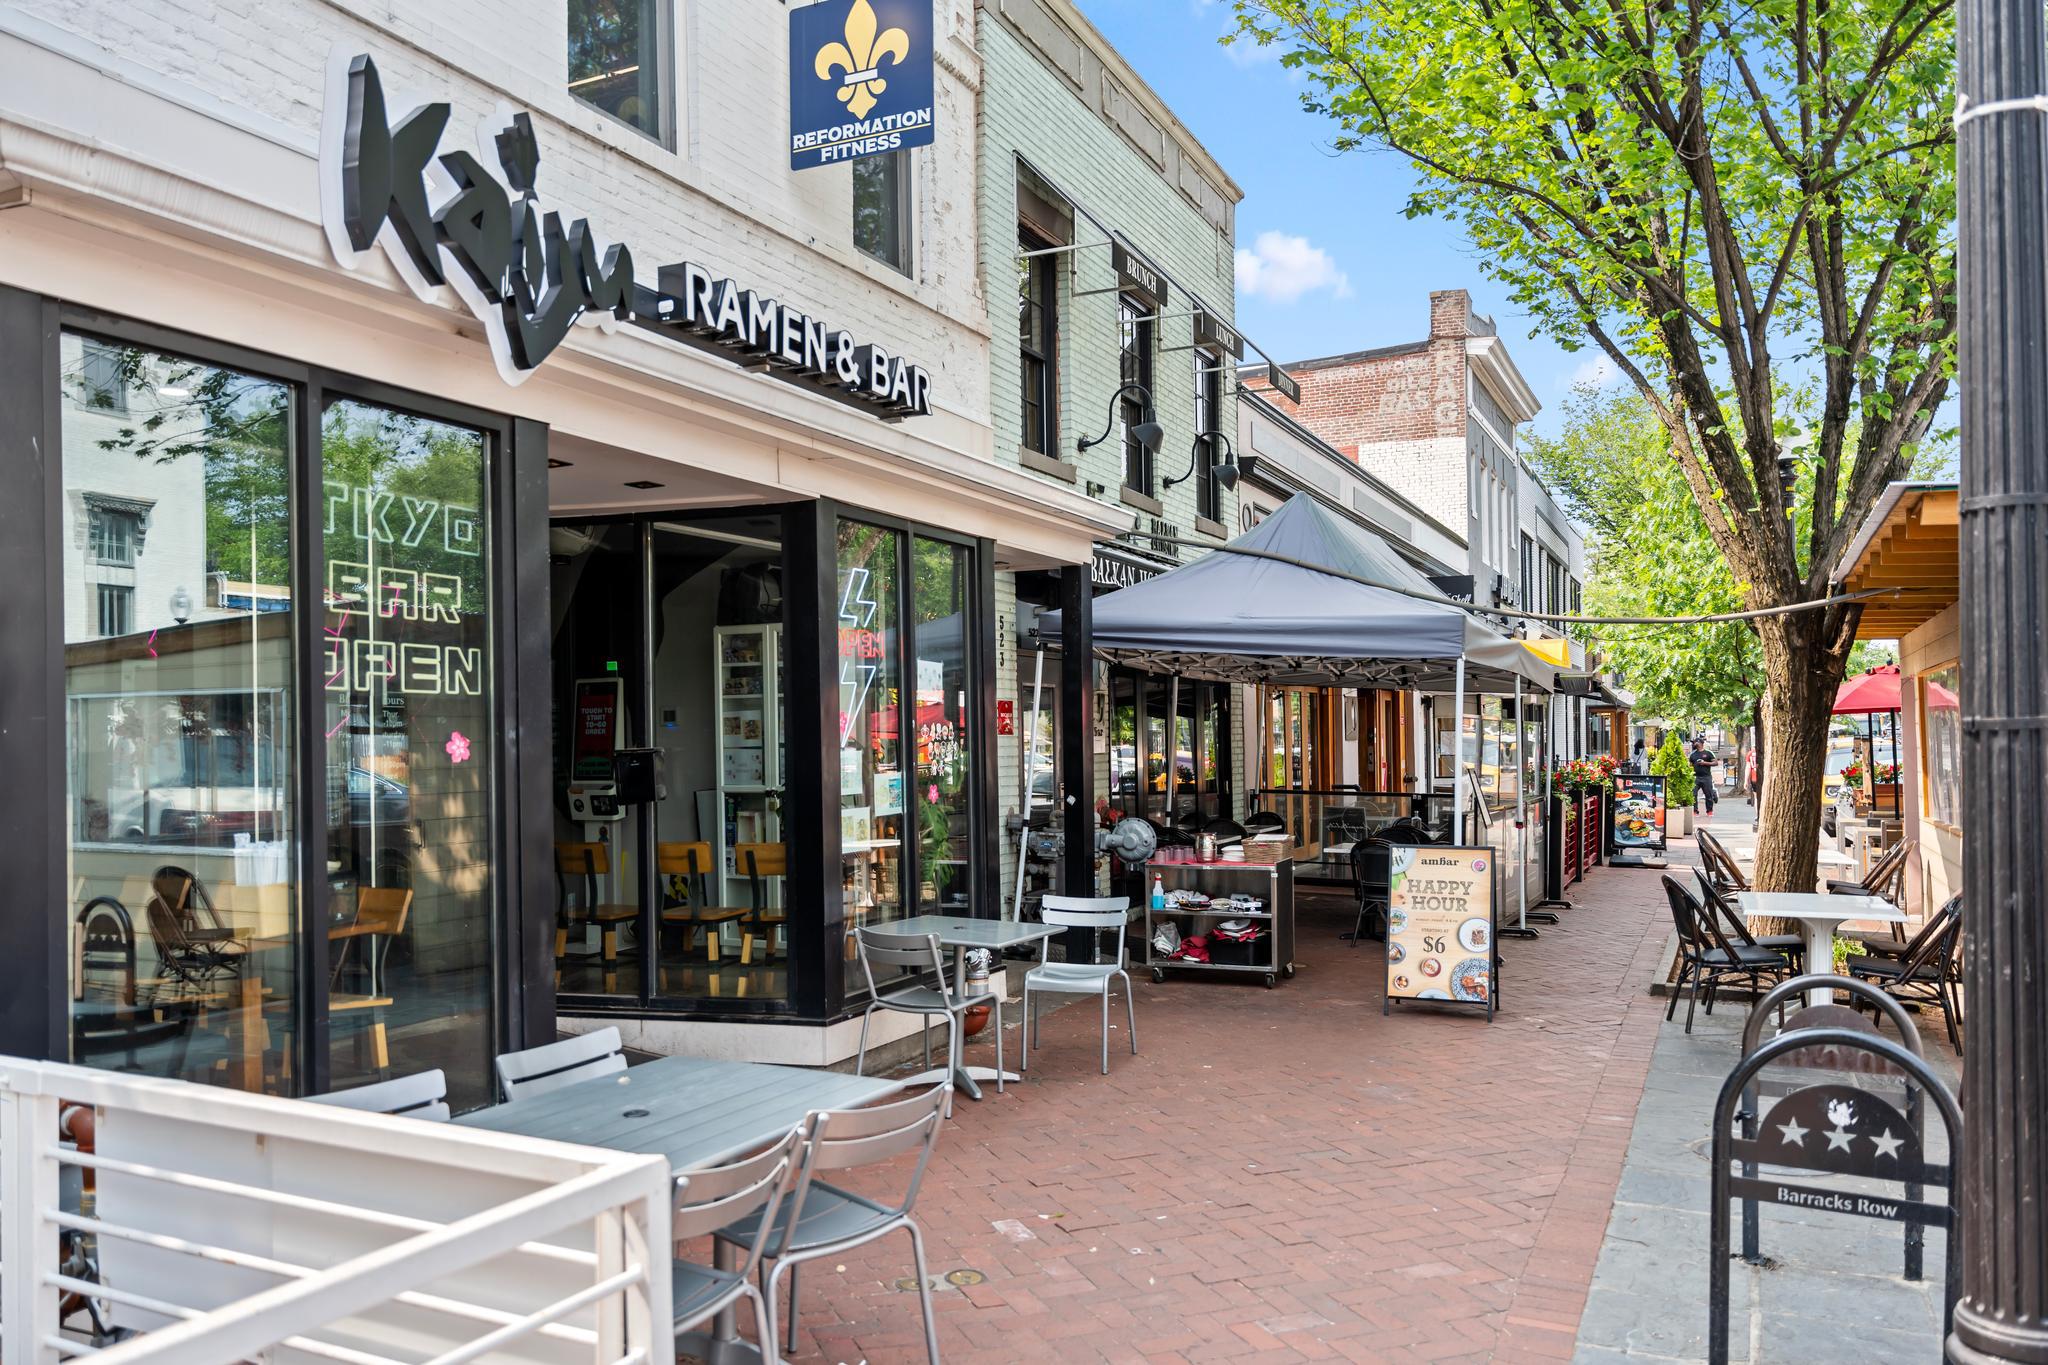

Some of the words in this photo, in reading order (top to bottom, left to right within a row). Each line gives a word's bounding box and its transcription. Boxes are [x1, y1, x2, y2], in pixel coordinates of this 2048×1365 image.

[792, 107, 932, 153] REFORMATION
[820, 132, 902, 163] FITNESS
[1126, 255, 1157, 294] BRUNCH
[685, 261, 827, 374] RAMEN
[835, 331, 861, 386] &
[870, 343, 933, 417] BAR
[1215, 323, 1235, 351] LUNCH
[1091, 555, 1136, 588] BALKAN
[329, 559, 462, 624] BAR
[998, 615, 1006, 667] 523
[324, 637, 482, 695] OPEN
[1406, 879, 1474, 896] HAPPY
[1411, 895, 1468, 912] HOUR
[1423, 936, 1447, 954] $6
[1776, 1186, 1853, 1212] Barracks
[1857, 1198, 1899, 1218] Row
